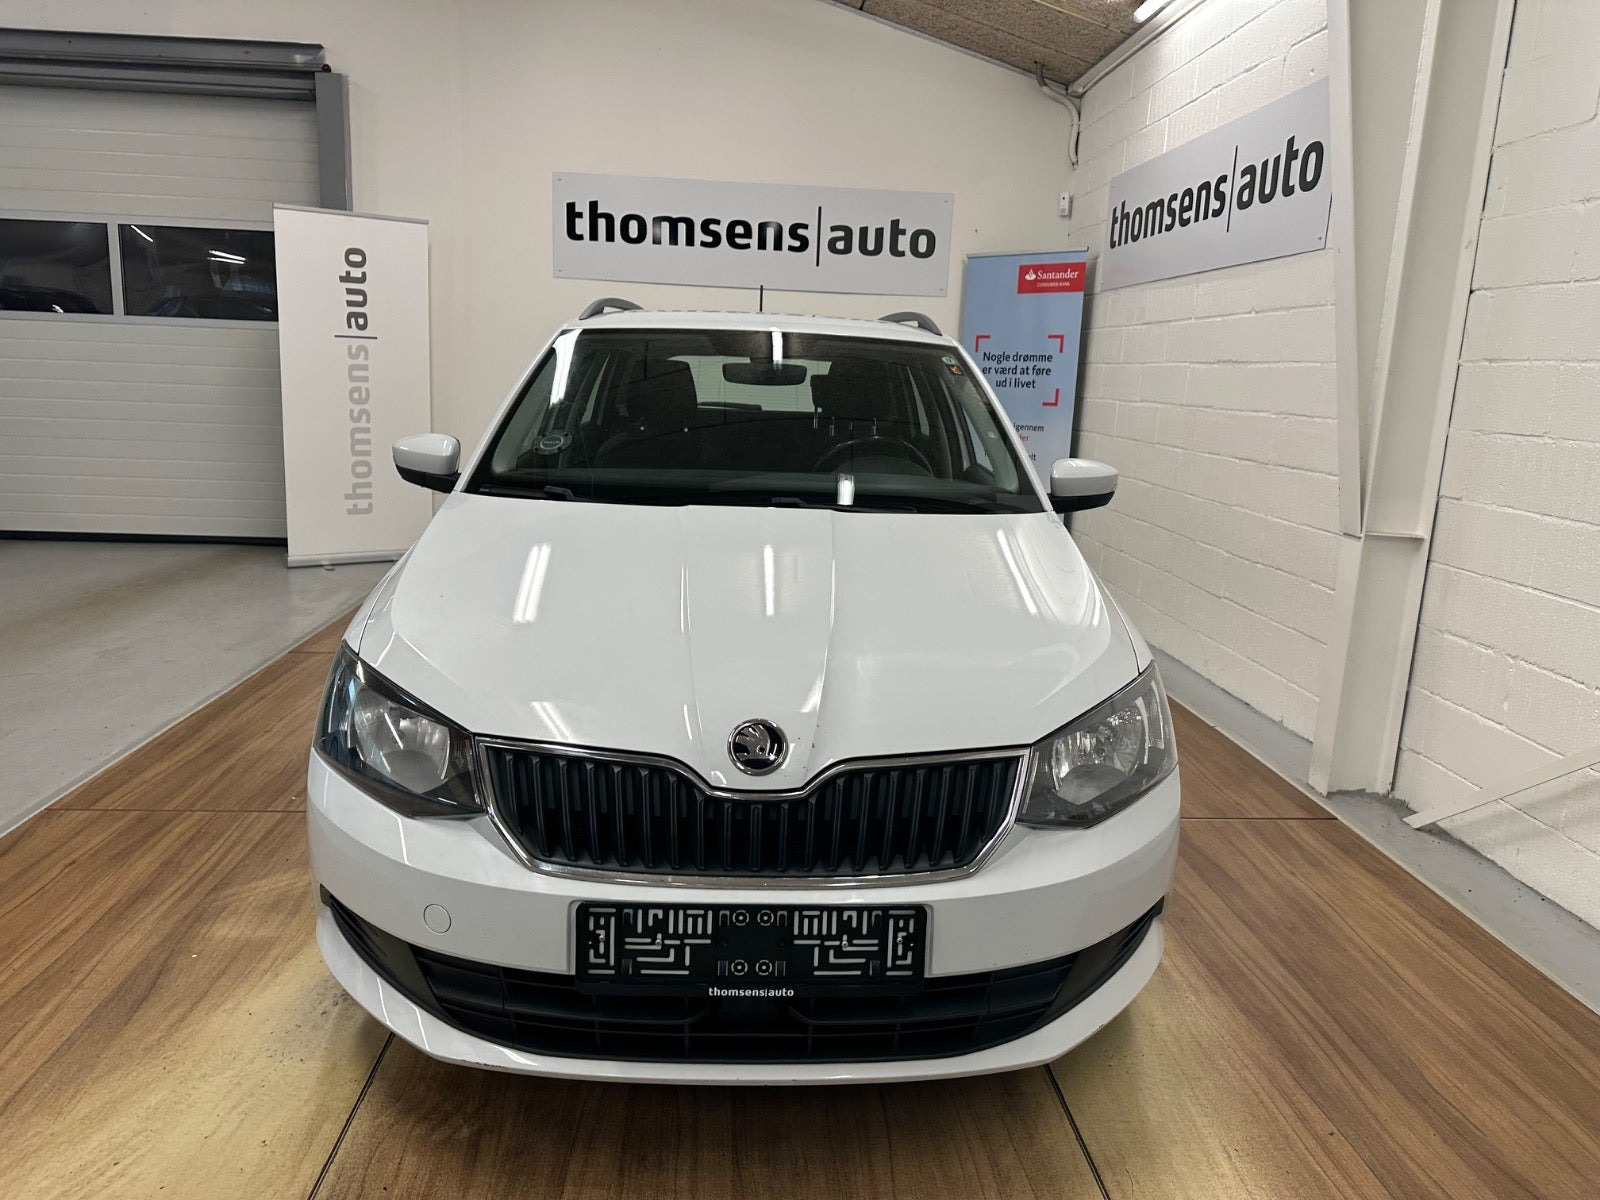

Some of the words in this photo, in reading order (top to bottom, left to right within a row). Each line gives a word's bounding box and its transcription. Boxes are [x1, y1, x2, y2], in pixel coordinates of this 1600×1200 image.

[1036, 267, 1079, 280] Santander
[983, 351, 1011, 365] Nogle
[1012, 351, 1053, 362] drømme
[982, 366, 993, 375] er
[994, 365, 1018, 375] værd
[1019, 366, 1030, 375] at
[1032, 365, 1052, 376] føre
[995, 377, 1007, 388] ud
[1014, 377, 1036, 388] livet
